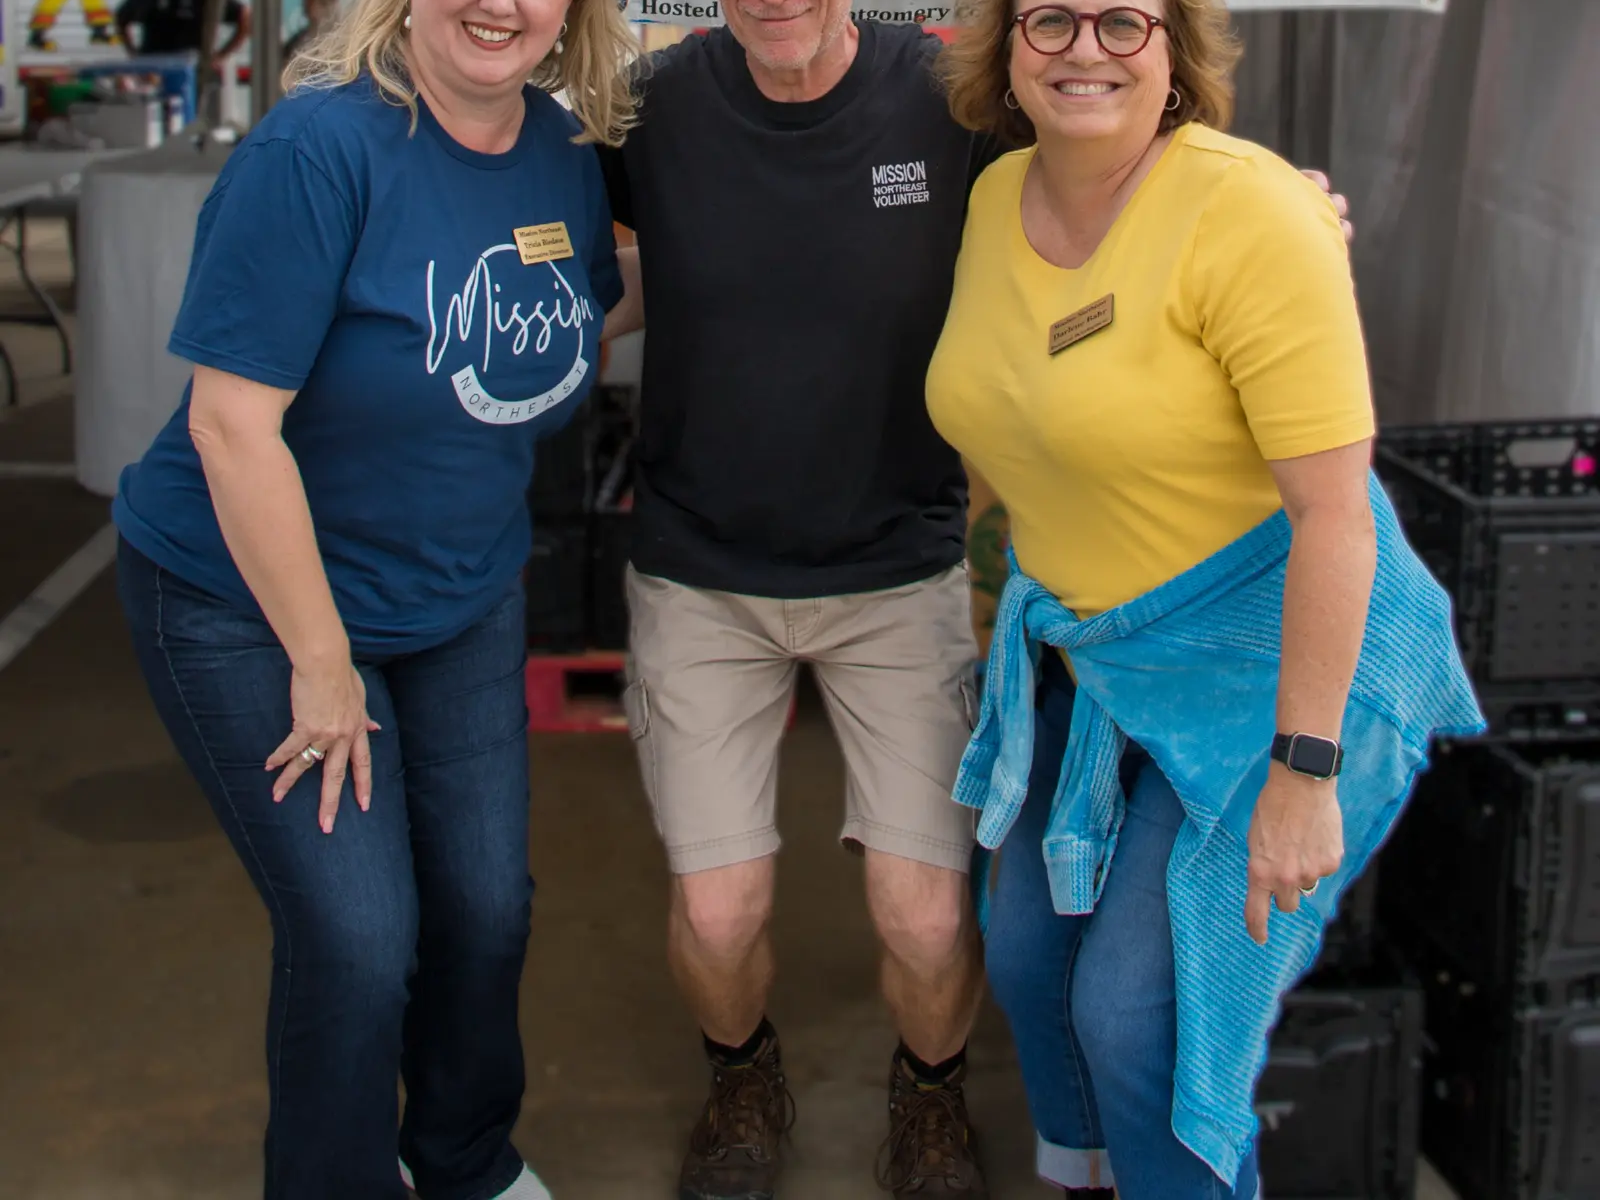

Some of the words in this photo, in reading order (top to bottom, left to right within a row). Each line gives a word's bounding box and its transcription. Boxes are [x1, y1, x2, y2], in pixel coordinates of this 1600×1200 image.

[872, 160, 926, 185] MISSION
[873, 191, 929, 208] VOLUNTEER
[874, 182, 927, 195] NORTHEAST
[426, 256, 594, 374] Mission
[459, 365, 584, 419] NORTHEAST
